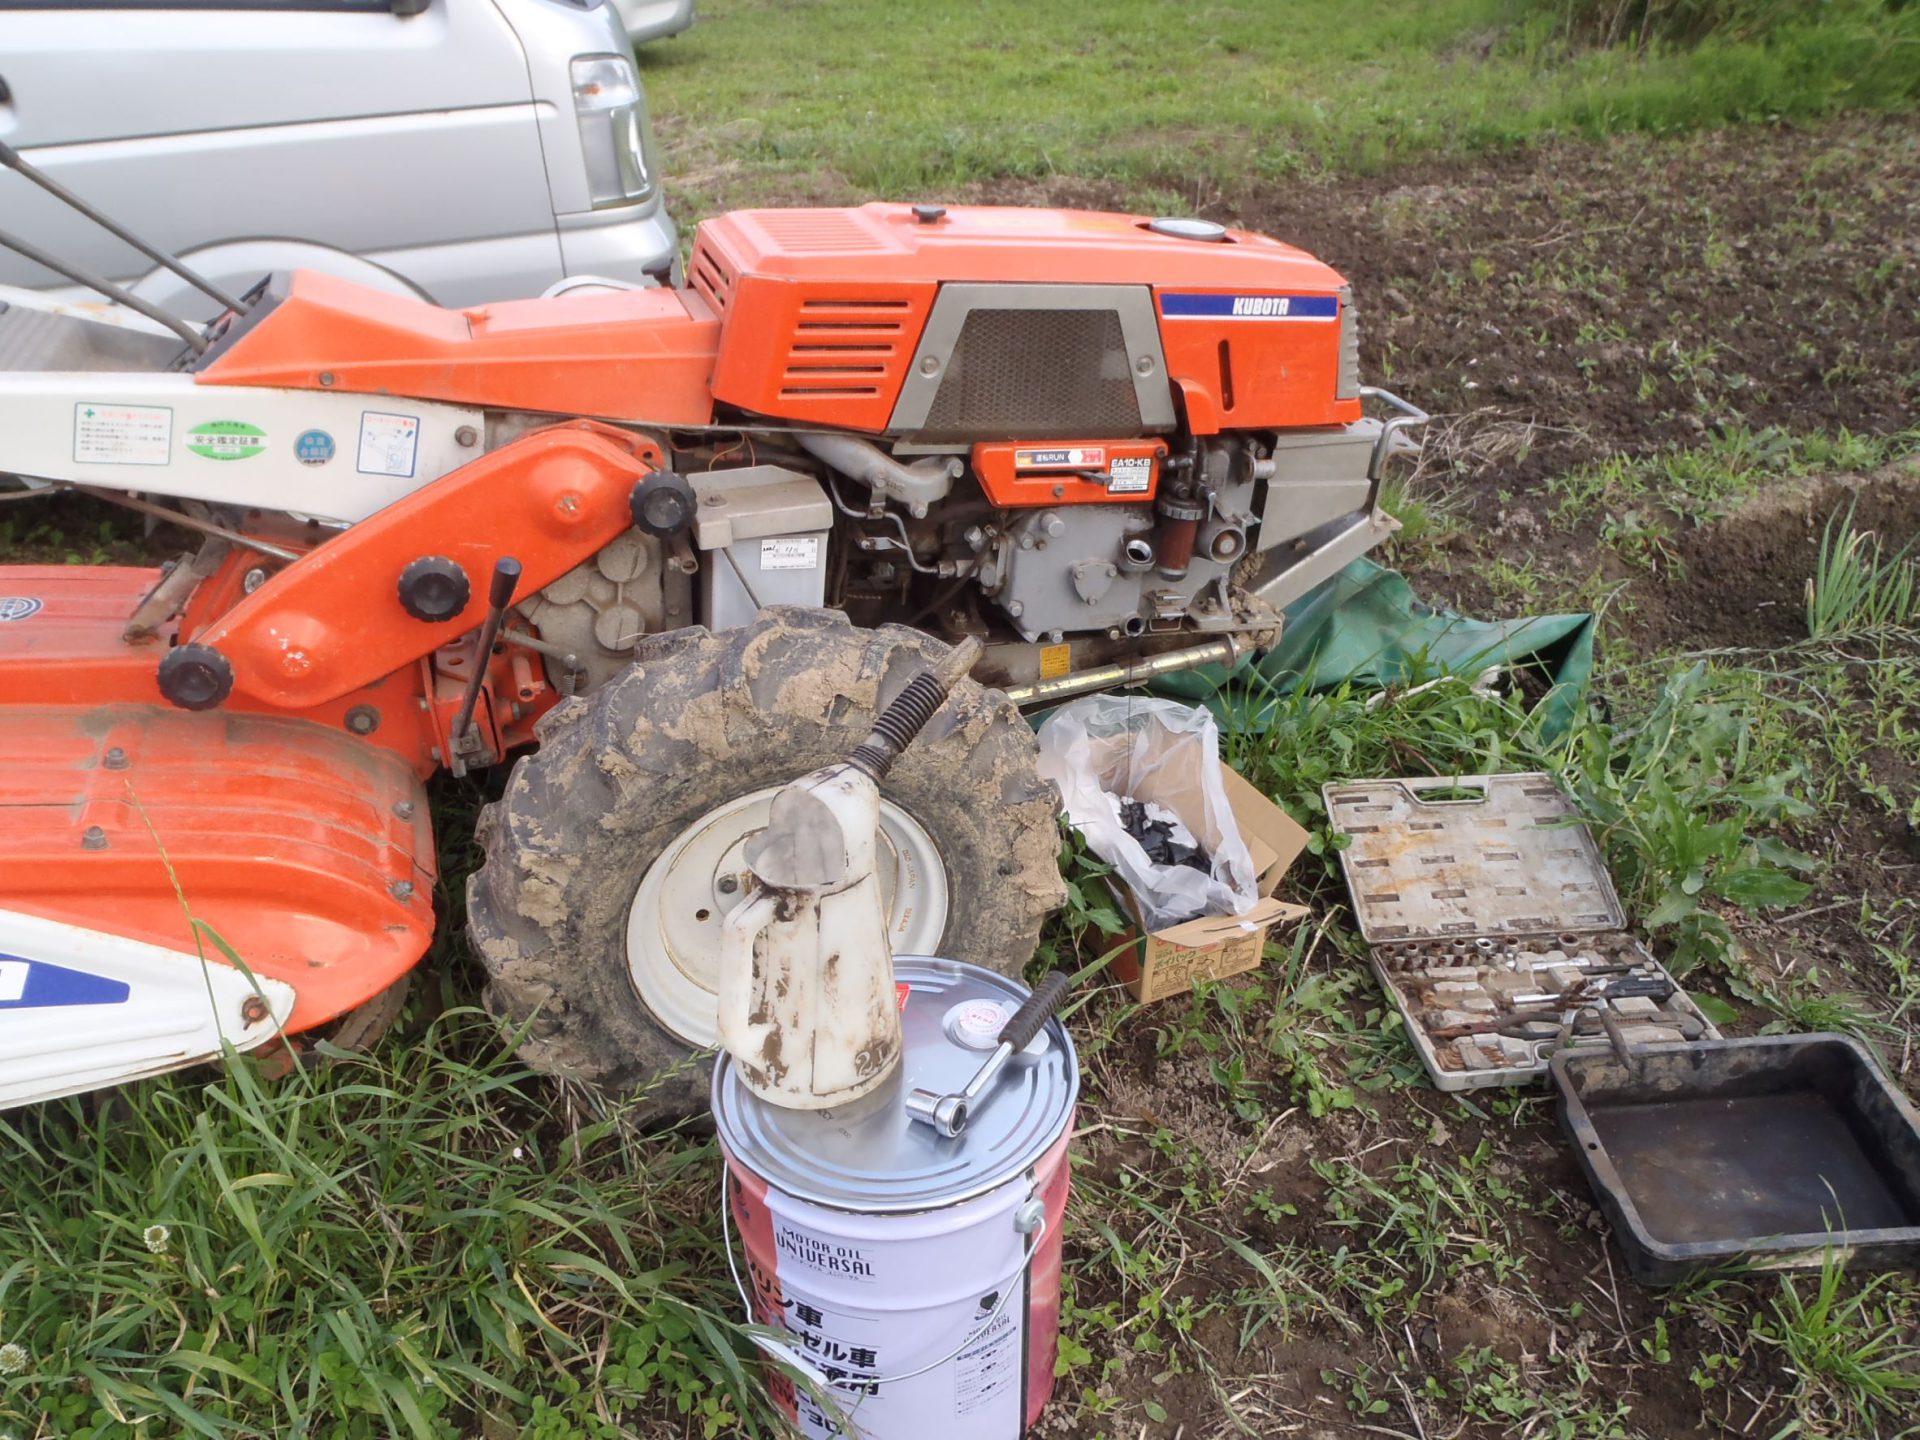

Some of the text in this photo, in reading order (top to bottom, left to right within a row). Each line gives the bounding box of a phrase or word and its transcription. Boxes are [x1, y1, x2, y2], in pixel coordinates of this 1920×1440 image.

[1232, 297, 1290, 316] KUBOTA
[776, 1232, 876, 1277] UNIVERSAL
[782, 1226, 864, 1261] MOTOR OIL
